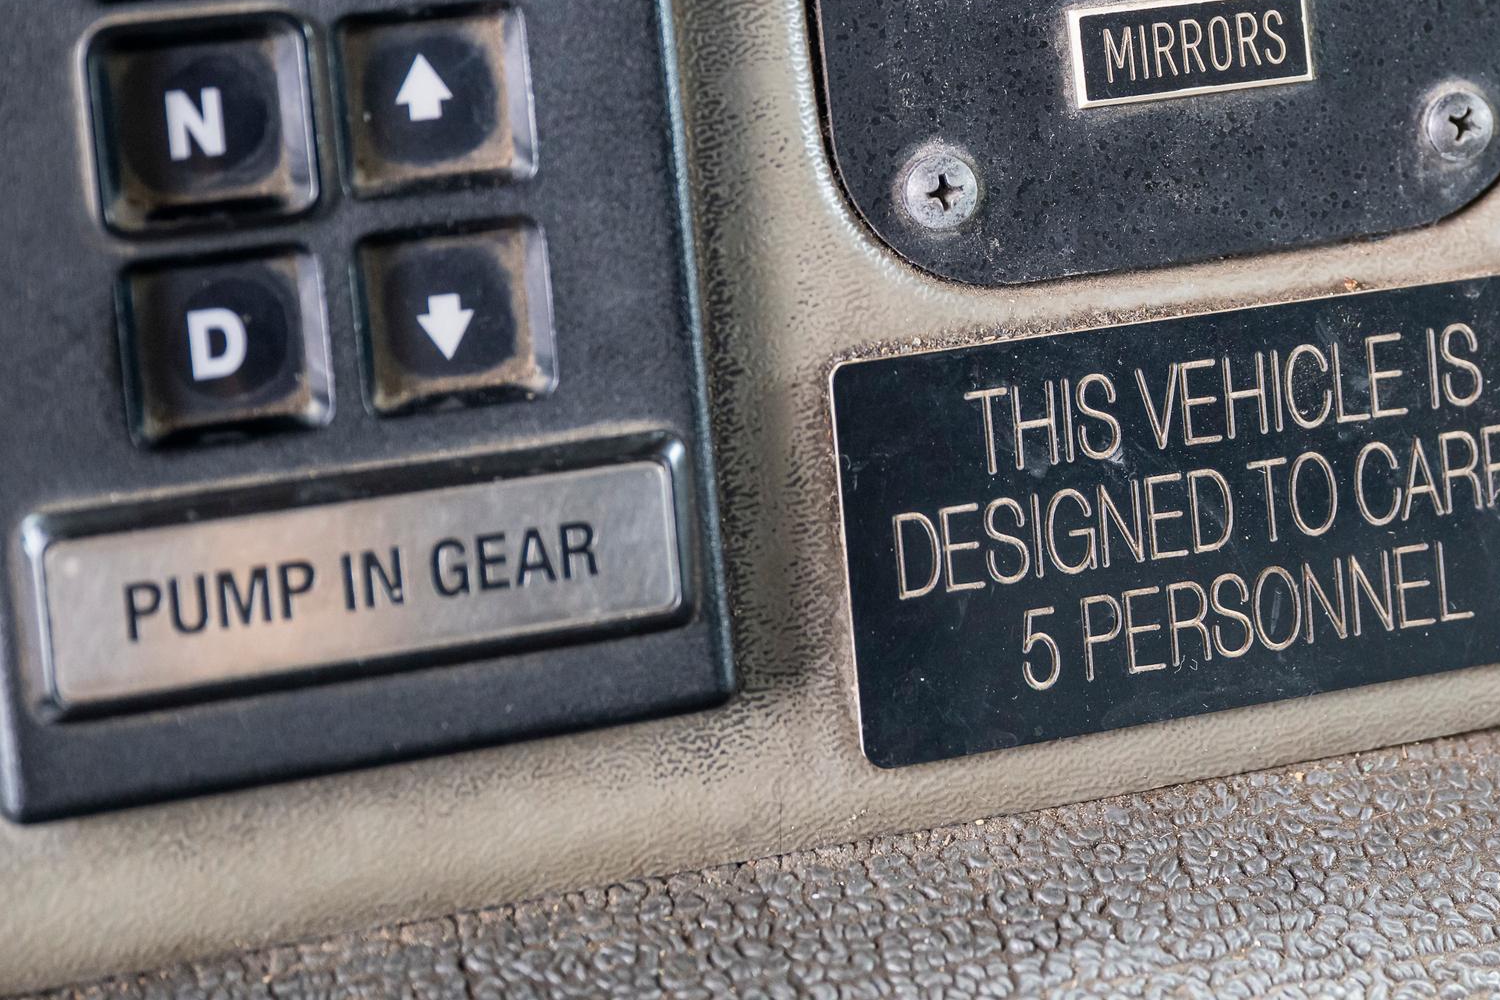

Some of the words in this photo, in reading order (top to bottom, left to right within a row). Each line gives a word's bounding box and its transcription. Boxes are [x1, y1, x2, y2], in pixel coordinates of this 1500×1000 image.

[1102, 9, 1288, 84] MIRRORS
[164, 87, 226, 160] N
[186, 307, 248, 381] D
[963, 373, 1123, 475] THIS
[1134, 331, 1409, 450] VEHICLE
[1426, 322, 1484, 411] IS
[123, 559, 316, 643] PUMP
[340, 545, 405, 612] IN
[429, 520, 600, 598] GEAR
[892, 466, 1233, 601] DESIGNED
[1246, 449, 1338, 543] TO
[1021, 605, 1062, 692] 5
[1079, 540, 1476, 681] PERSONNEL
